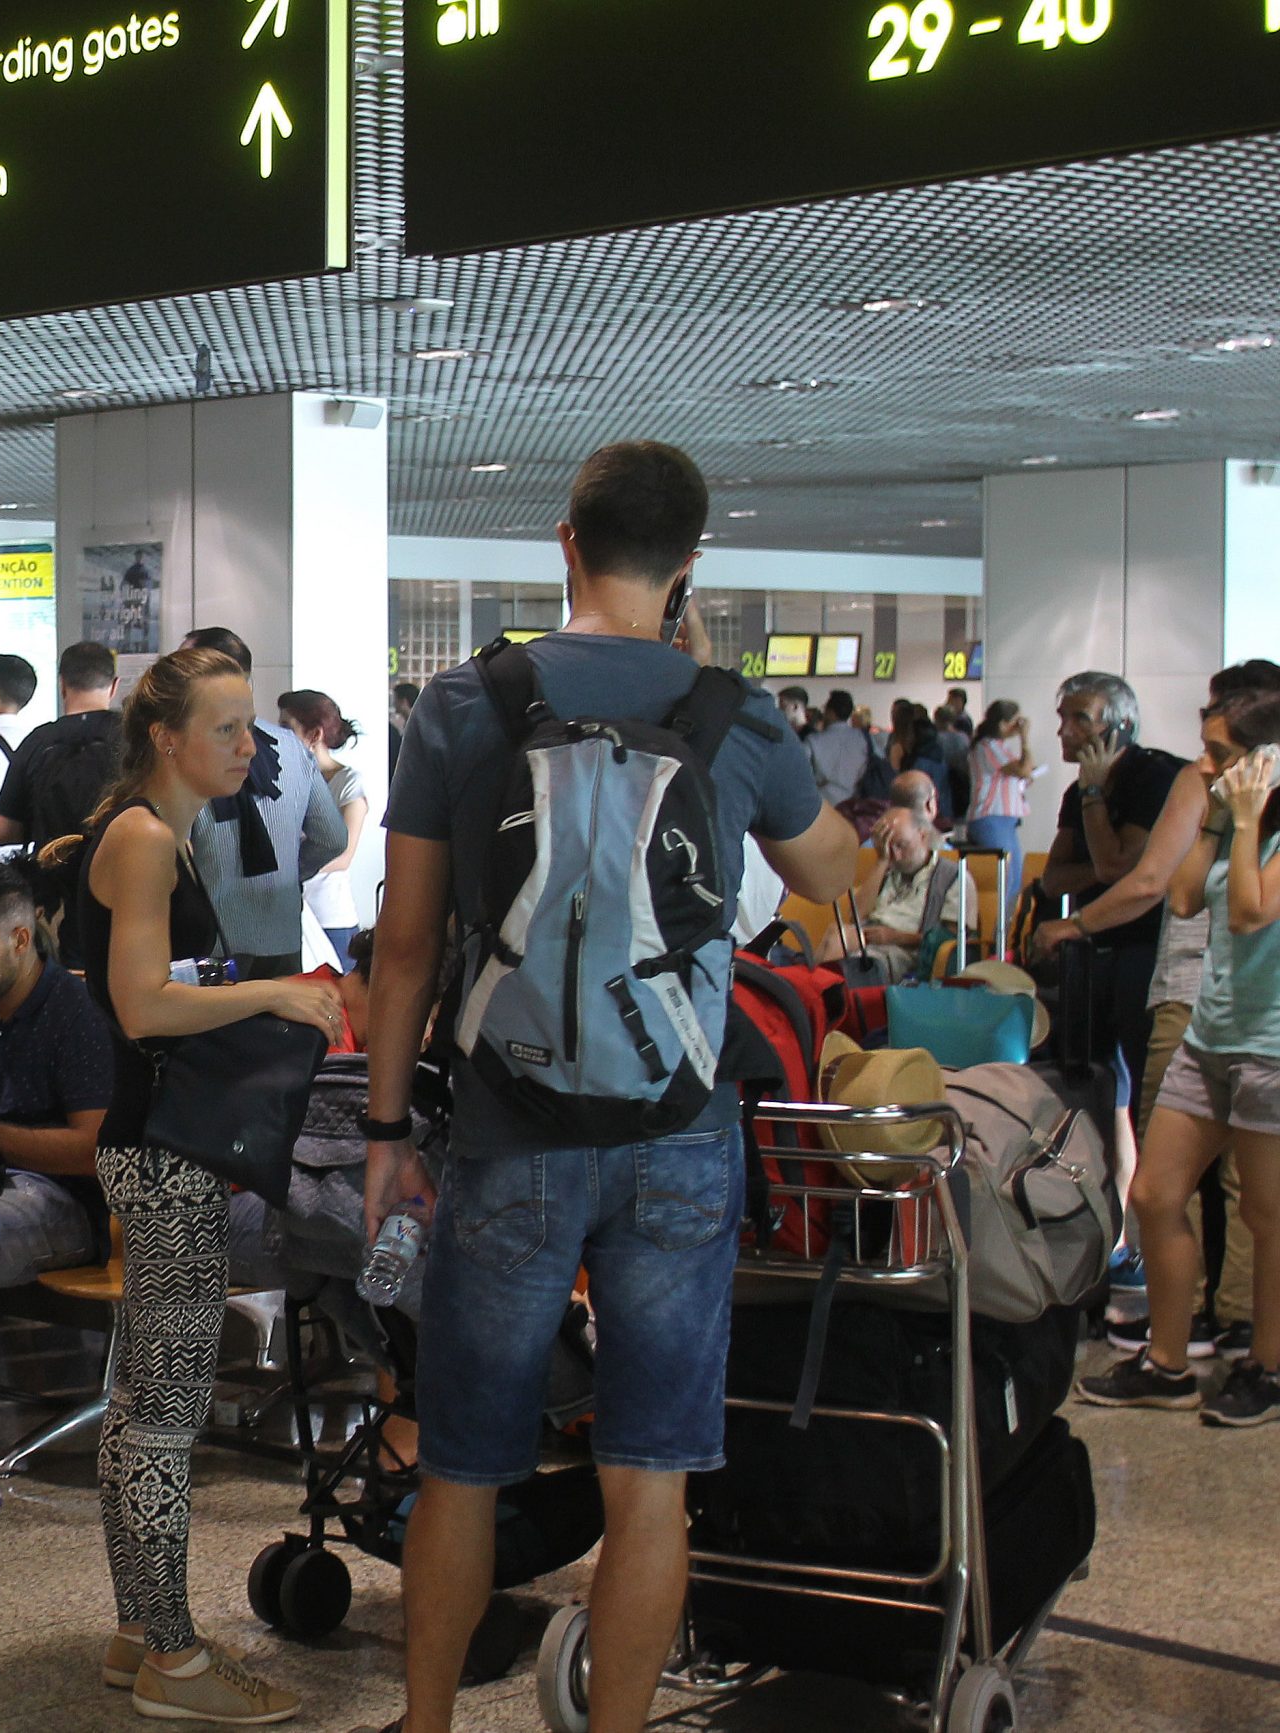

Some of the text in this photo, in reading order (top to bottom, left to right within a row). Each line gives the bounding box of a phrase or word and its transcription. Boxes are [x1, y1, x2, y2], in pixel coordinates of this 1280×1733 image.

[82, 11, 180, 77] gates
[867, 0, 1114, 82] 29 - 40
[741, 650, 765, 678] 26
[874, 651, 896, 679] 27
[943, 650, 967, 680] 28
